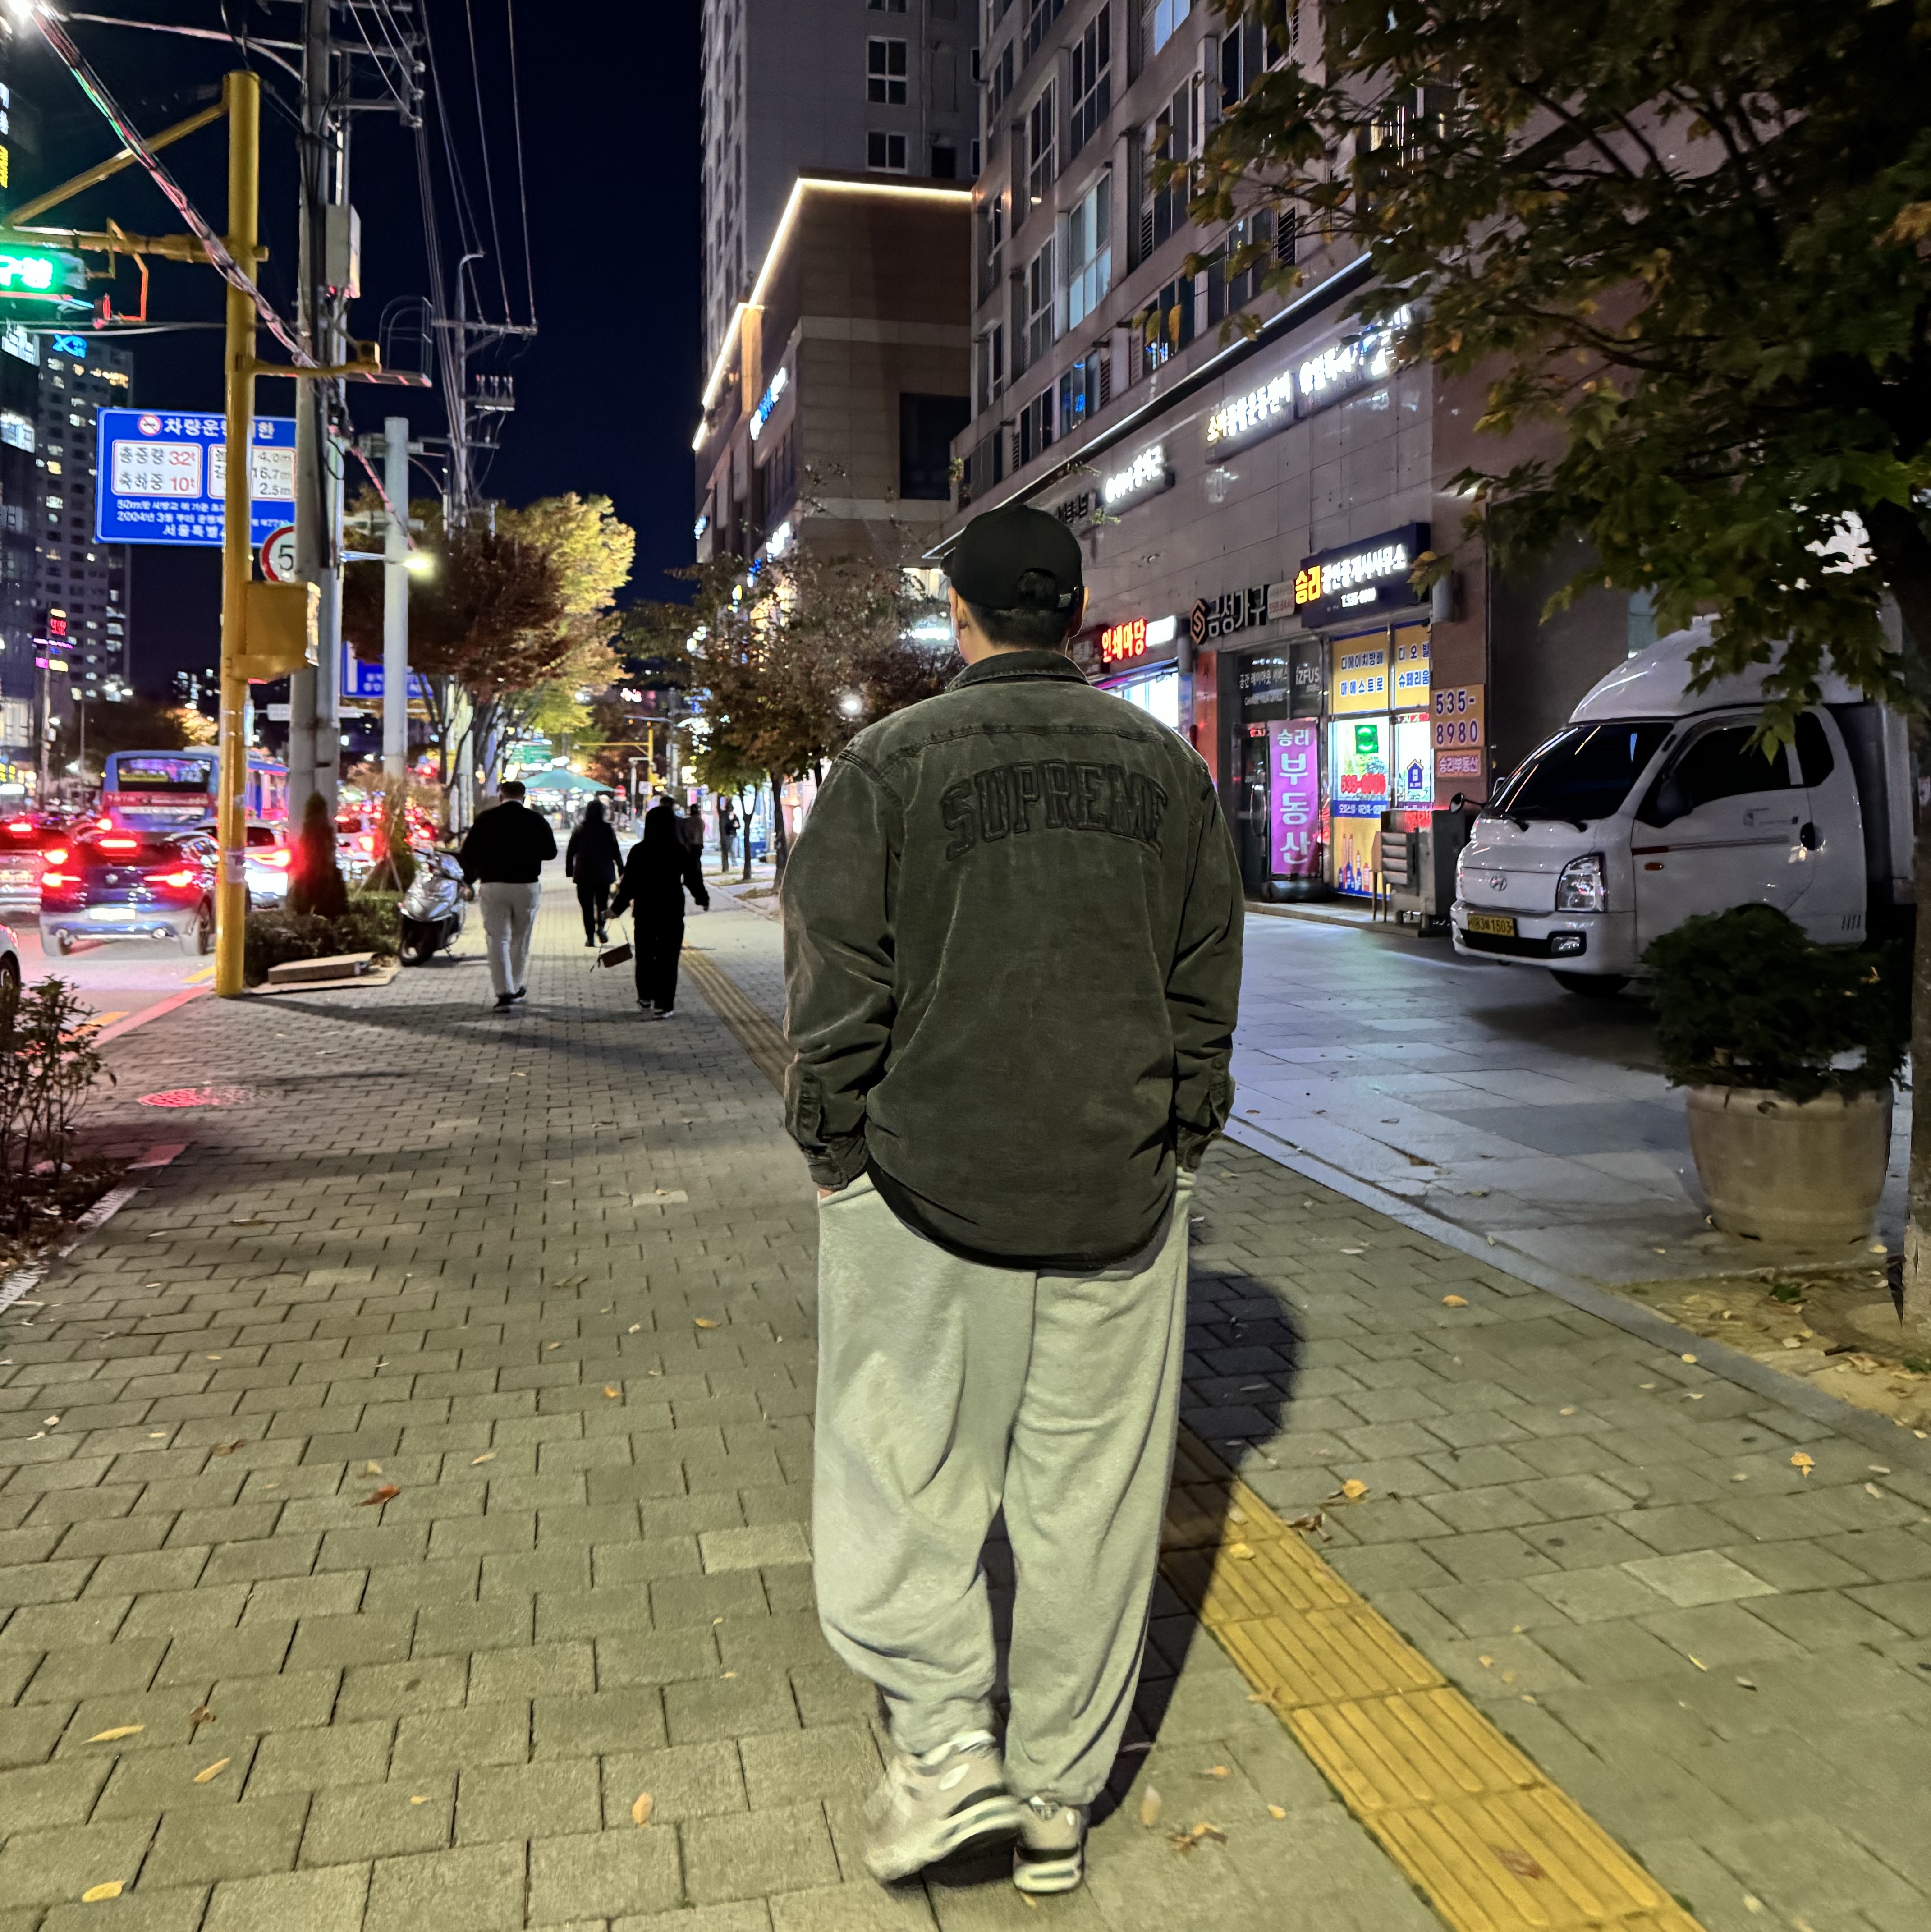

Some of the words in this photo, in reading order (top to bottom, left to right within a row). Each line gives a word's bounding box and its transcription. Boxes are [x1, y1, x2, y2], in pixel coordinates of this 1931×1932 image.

[259, 483, 291, 496] 2.5m
[1295, 565, 1321, 604] 승리
[1321, 544, 1406, 594] 공인중개사사무소
[1207, 584, 1266, 635] 금성가구
[1101, 618, 1146, 663] 인쇄마당
[1341, 651, 1383, 670] 디에이치방배
[1436, 691, 1474, 715] 535-
[1277, 729, 1310, 747] 승리
[1436, 724, 1478, 745] 8980
[1438, 756, 1481, 774] 승리부동산
[1280, 753, 1311, 865] 부동산
